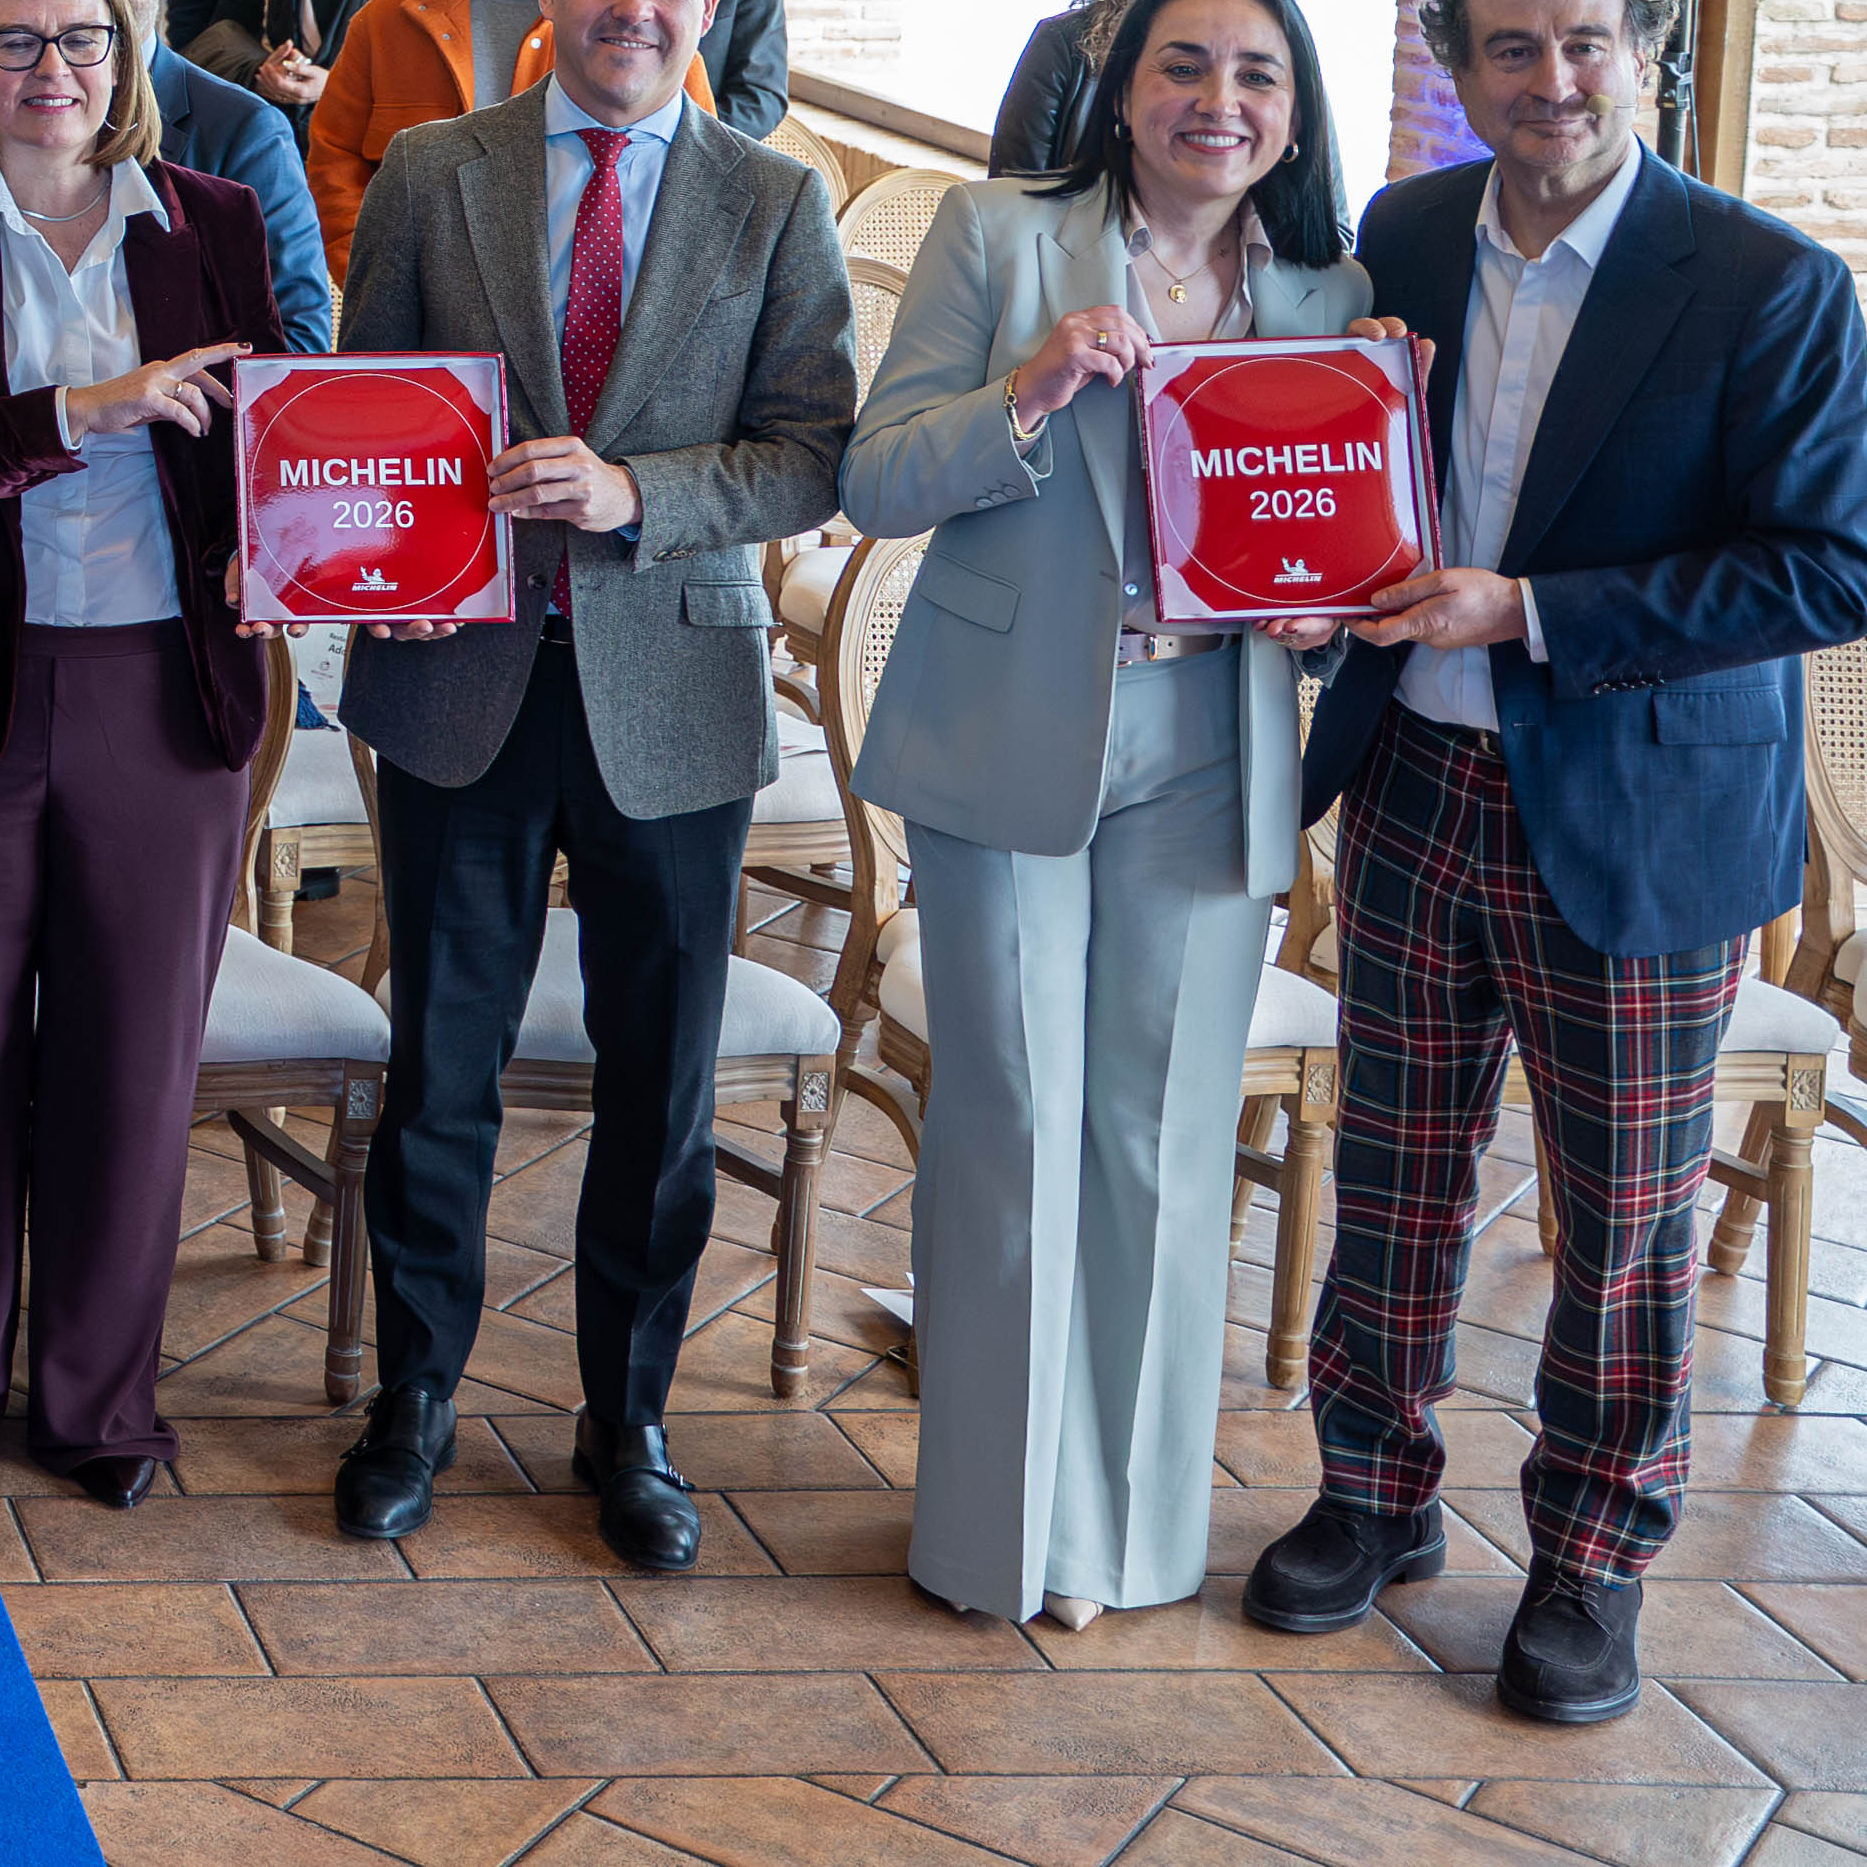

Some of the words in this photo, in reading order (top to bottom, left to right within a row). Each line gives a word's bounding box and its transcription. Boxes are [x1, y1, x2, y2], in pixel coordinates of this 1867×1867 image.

[279, 457, 462, 487] MICHELIN
[1190, 441, 1382, 478] MICHELIN
[332, 500, 414, 529] 2026
[1249, 487, 1336, 520] 2026
[351, 583, 398, 592] MICHELIN
[1273, 575, 1322, 584] MICHELIN
